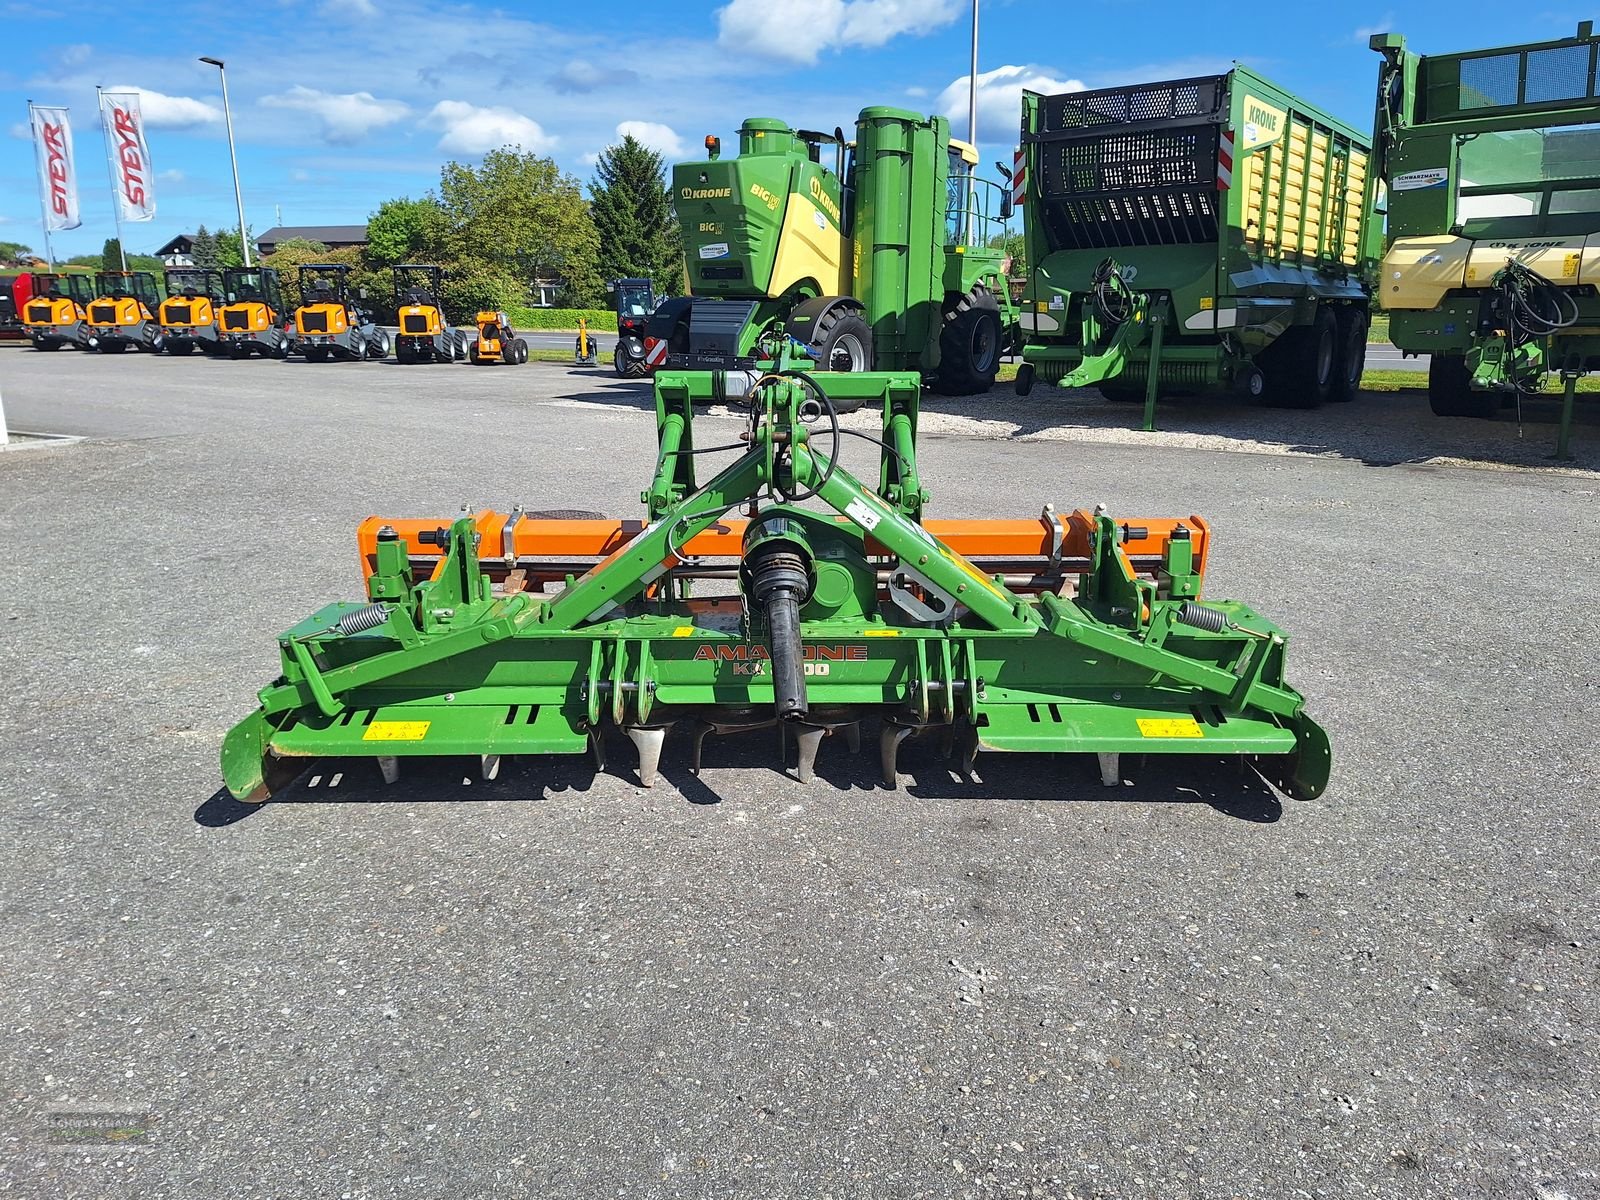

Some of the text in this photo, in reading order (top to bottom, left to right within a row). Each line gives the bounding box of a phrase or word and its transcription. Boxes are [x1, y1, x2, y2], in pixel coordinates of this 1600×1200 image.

[1249, 105, 1277, 132] KRONE
[113, 107, 146, 208] STEYR
[43, 122, 68, 218] STEYR
[1398, 173, 1440, 181] SCHWARZMAYR
[692, 188, 732, 199] KRONE
[820, 189, 840, 224] KRONE
[1507, 241, 1566, 249] KONE
[693, 644, 868, 661] AMAONE
